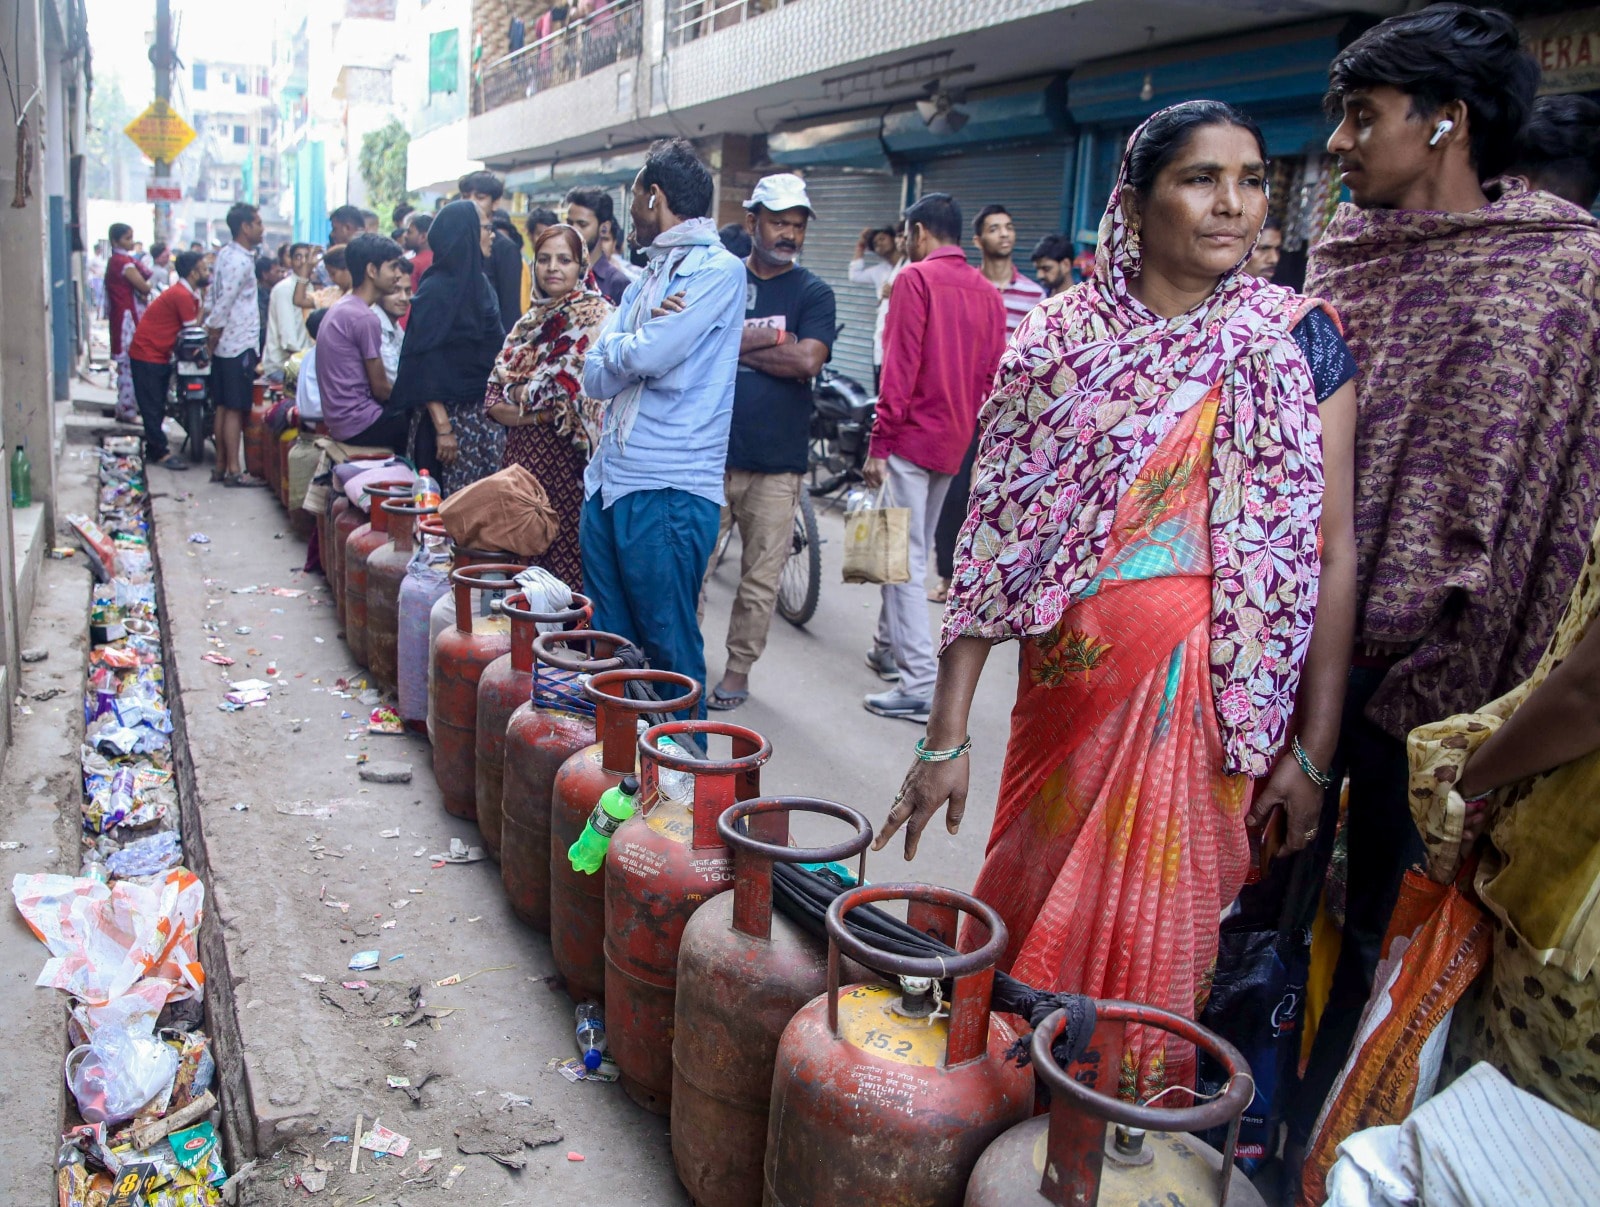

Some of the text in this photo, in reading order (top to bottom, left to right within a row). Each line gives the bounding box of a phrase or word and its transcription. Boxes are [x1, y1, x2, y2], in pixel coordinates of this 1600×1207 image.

[1530, 31, 1600, 72] ERA
[863, 1029, 913, 1058] 15.2
[1380, 1070, 1406, 1115] Chakki
[1426, 1004, 1449, 1032] Atta
[859, 1080, 895, 1093] SWITCH
[1240, 1116, 1263, 1124] rams
[1234, 1144, 1263, 1156] ymond
[119, 1173, 139, 1193] 8
